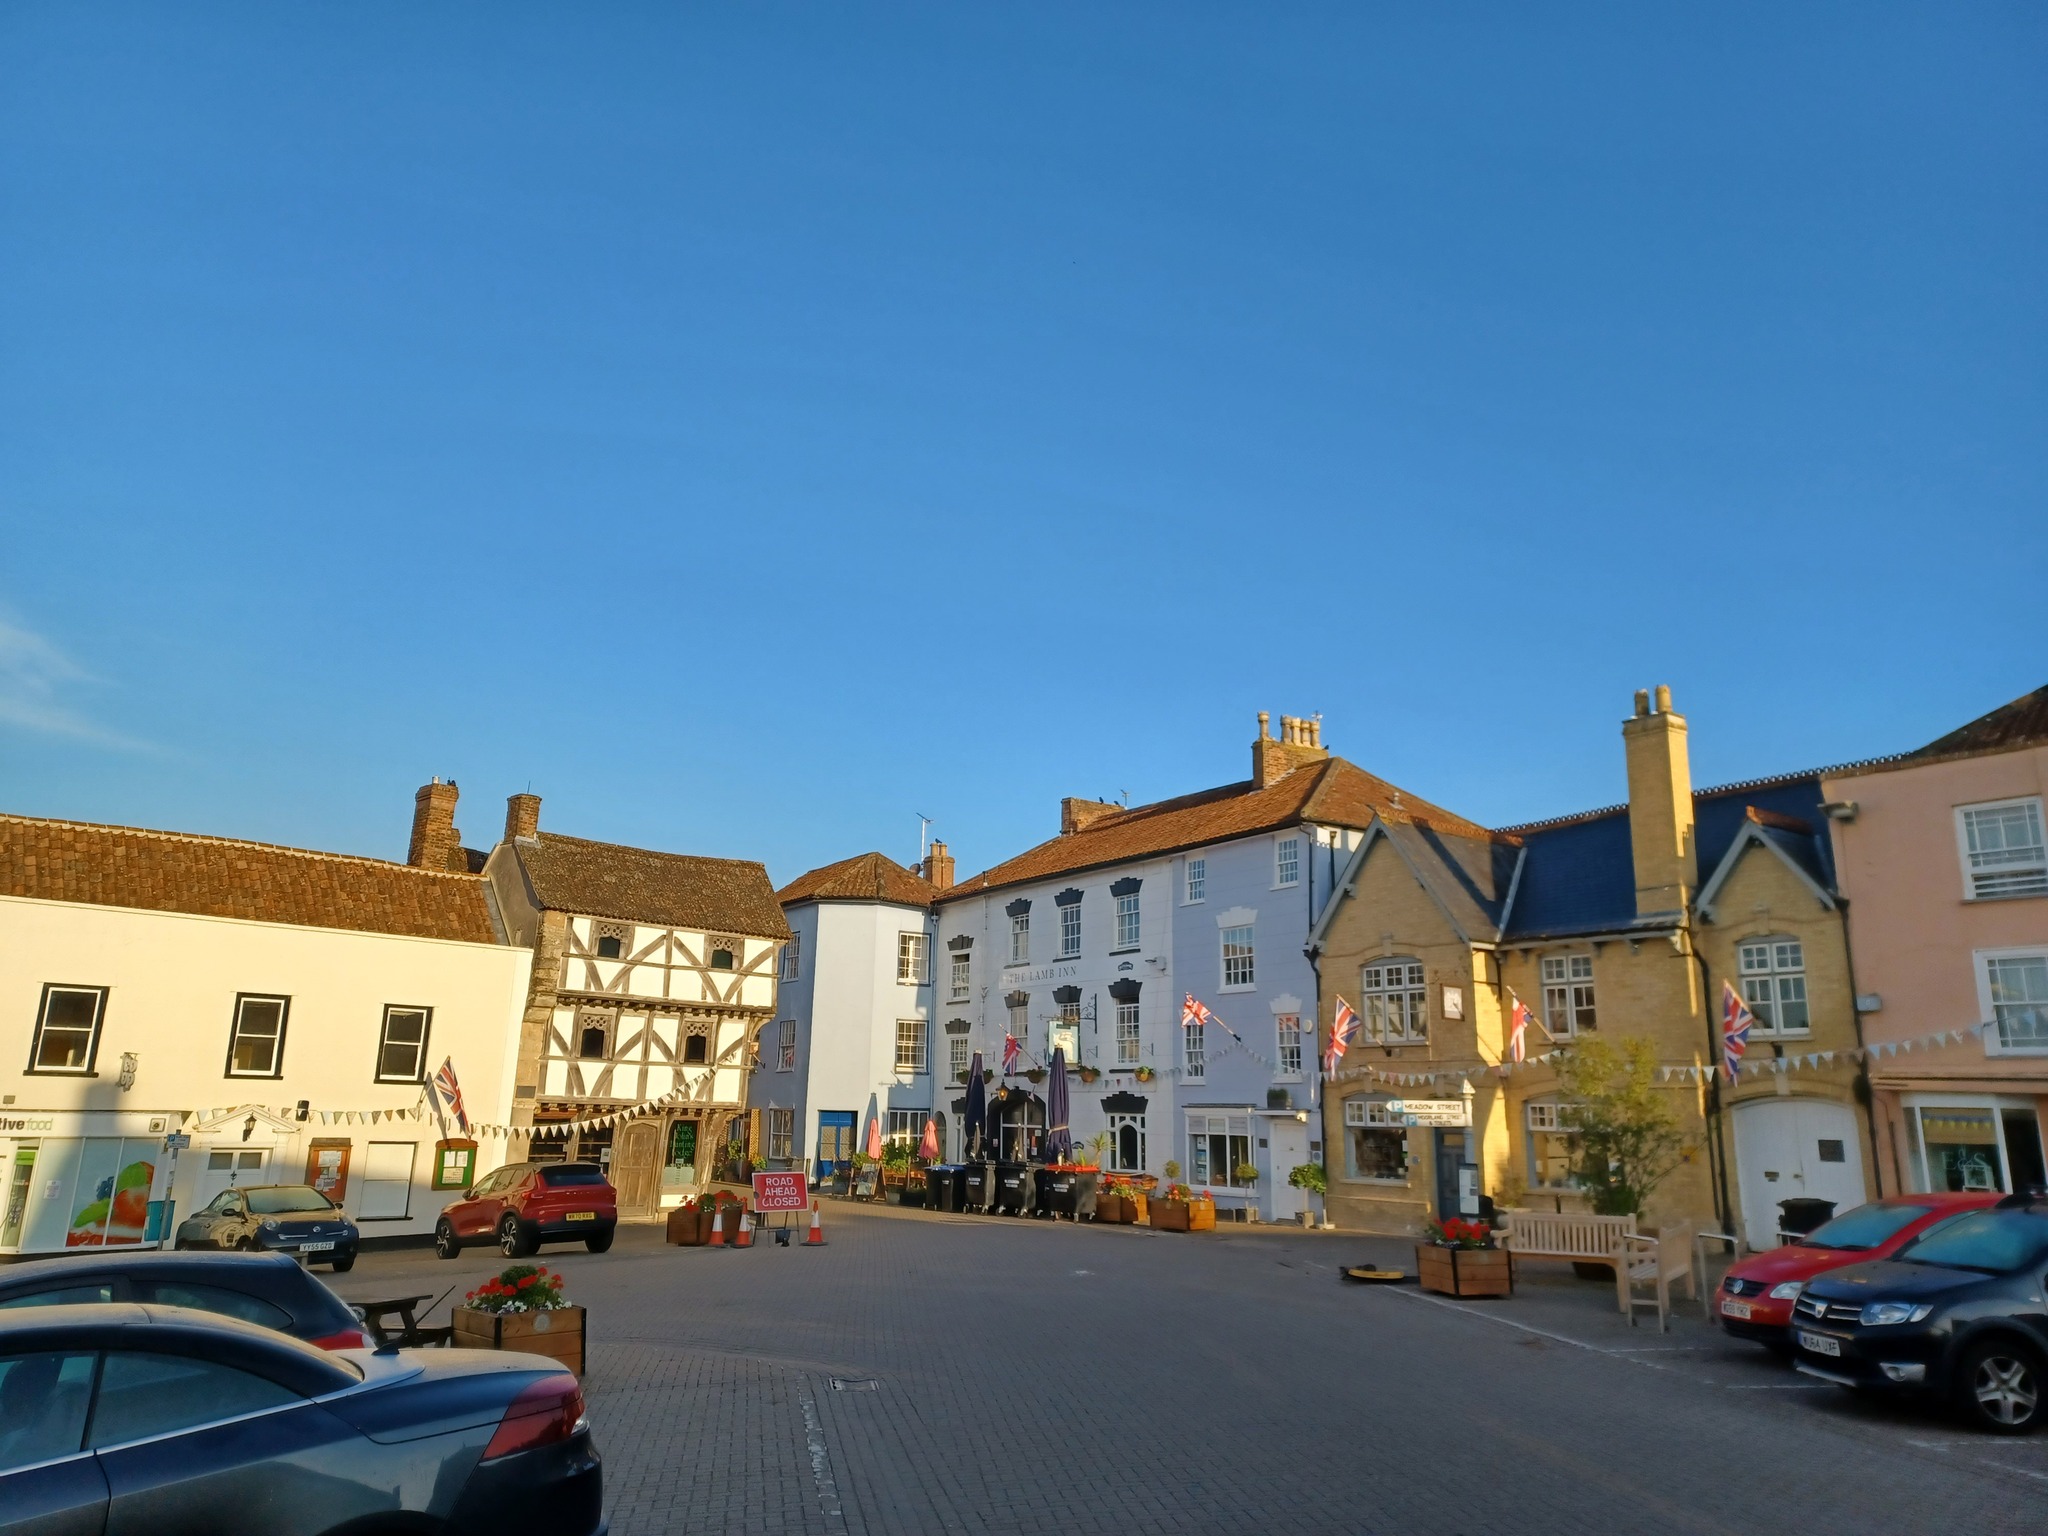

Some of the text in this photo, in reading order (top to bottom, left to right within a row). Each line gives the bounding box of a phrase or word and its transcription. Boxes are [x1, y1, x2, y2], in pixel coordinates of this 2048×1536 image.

[1009, 965, 1077, 984] THE LAMB INN
[26, 1117, 53, 1131] food
[765, 1177, 794, 1186] ROAD
[764, 1187, 797, 1197] AHEAD
[762, 1197, 801, 1207] CLOSED
[302, 1243, 319, 1251] YY55
